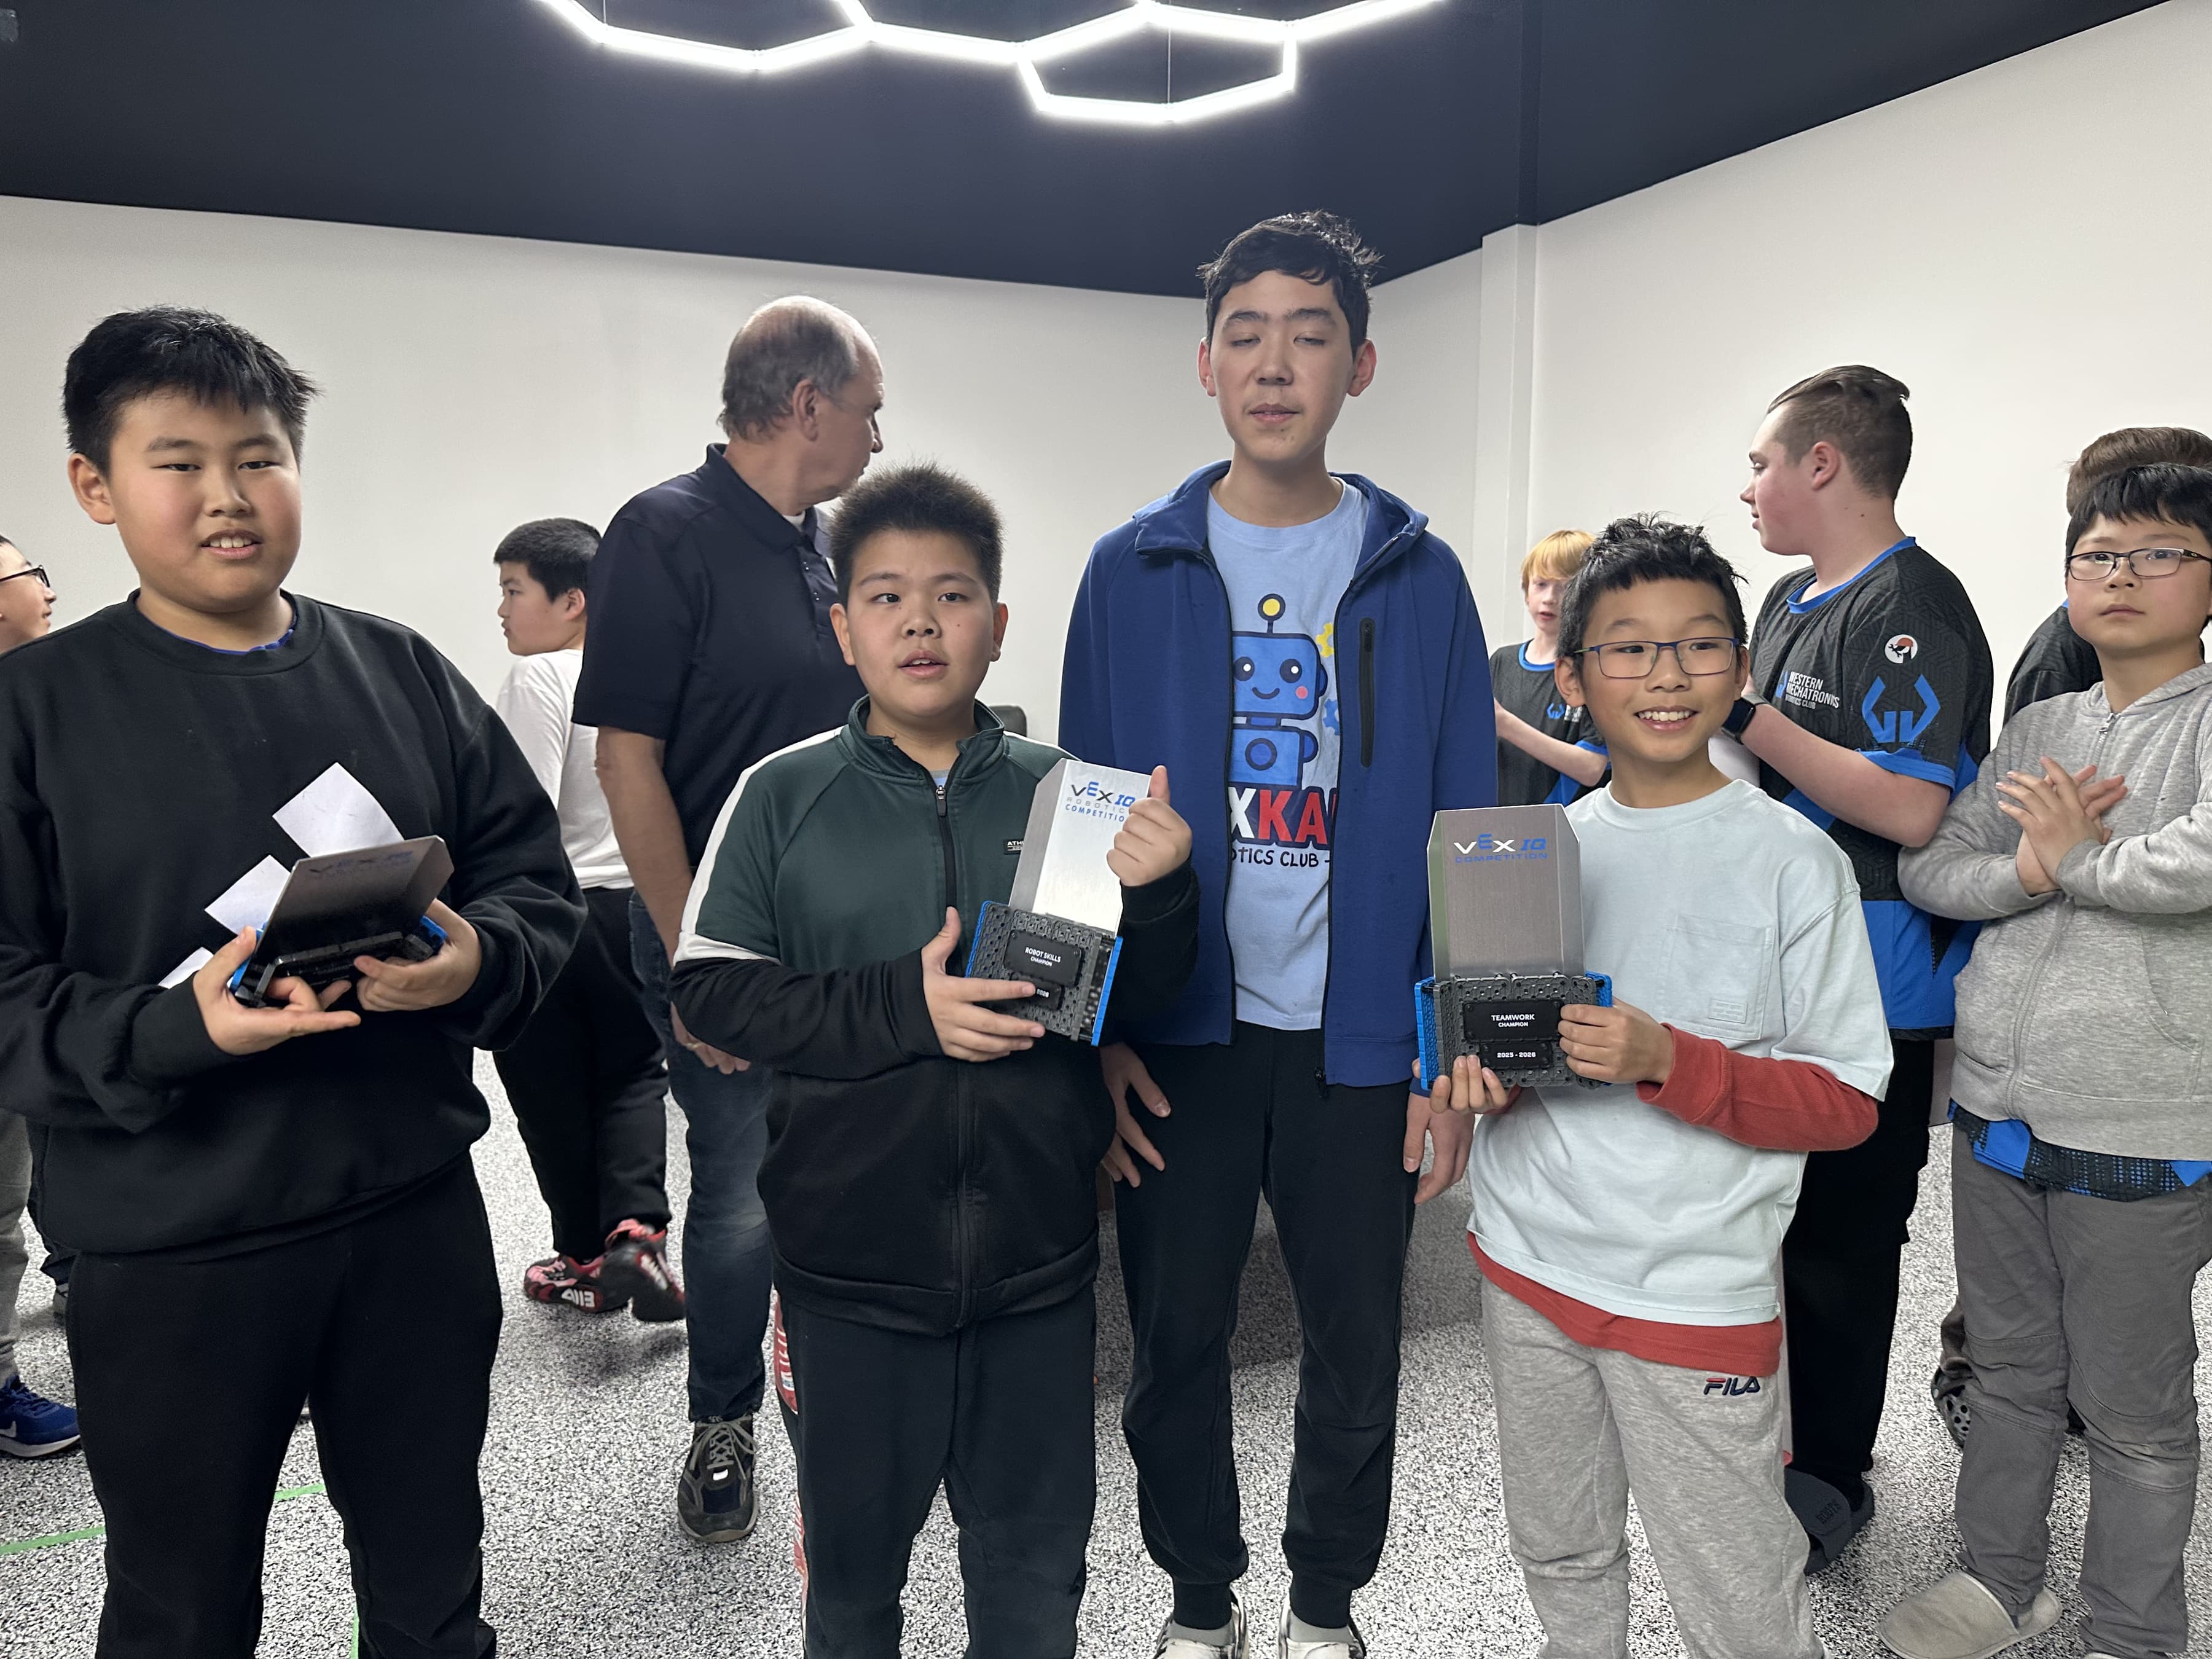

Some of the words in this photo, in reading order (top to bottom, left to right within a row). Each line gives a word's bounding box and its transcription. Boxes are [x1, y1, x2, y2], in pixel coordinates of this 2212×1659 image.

[1789, 671, 1824, 690] WESTERN
[1071, 781, 1113, 804] VEX
[1065, 804, 1124, 822] COMPETITIO
[1067, 796, 1125, 814] ROBOTIC
[1228, 786, 1336, 845] XKA
[1453, 833, 1516, 855] VEX
[1280, 851, 1319, 868] CLUB
[1455, 852, 1548, 864] COMPETITION
[1025, 947, 1043, 957] ROBOT
[1043, 952, 1061, 963] SKILLS
[1030, 956, 1053, 967] CHAMPION
[1703, 1376, 1760, 1396] FILA
